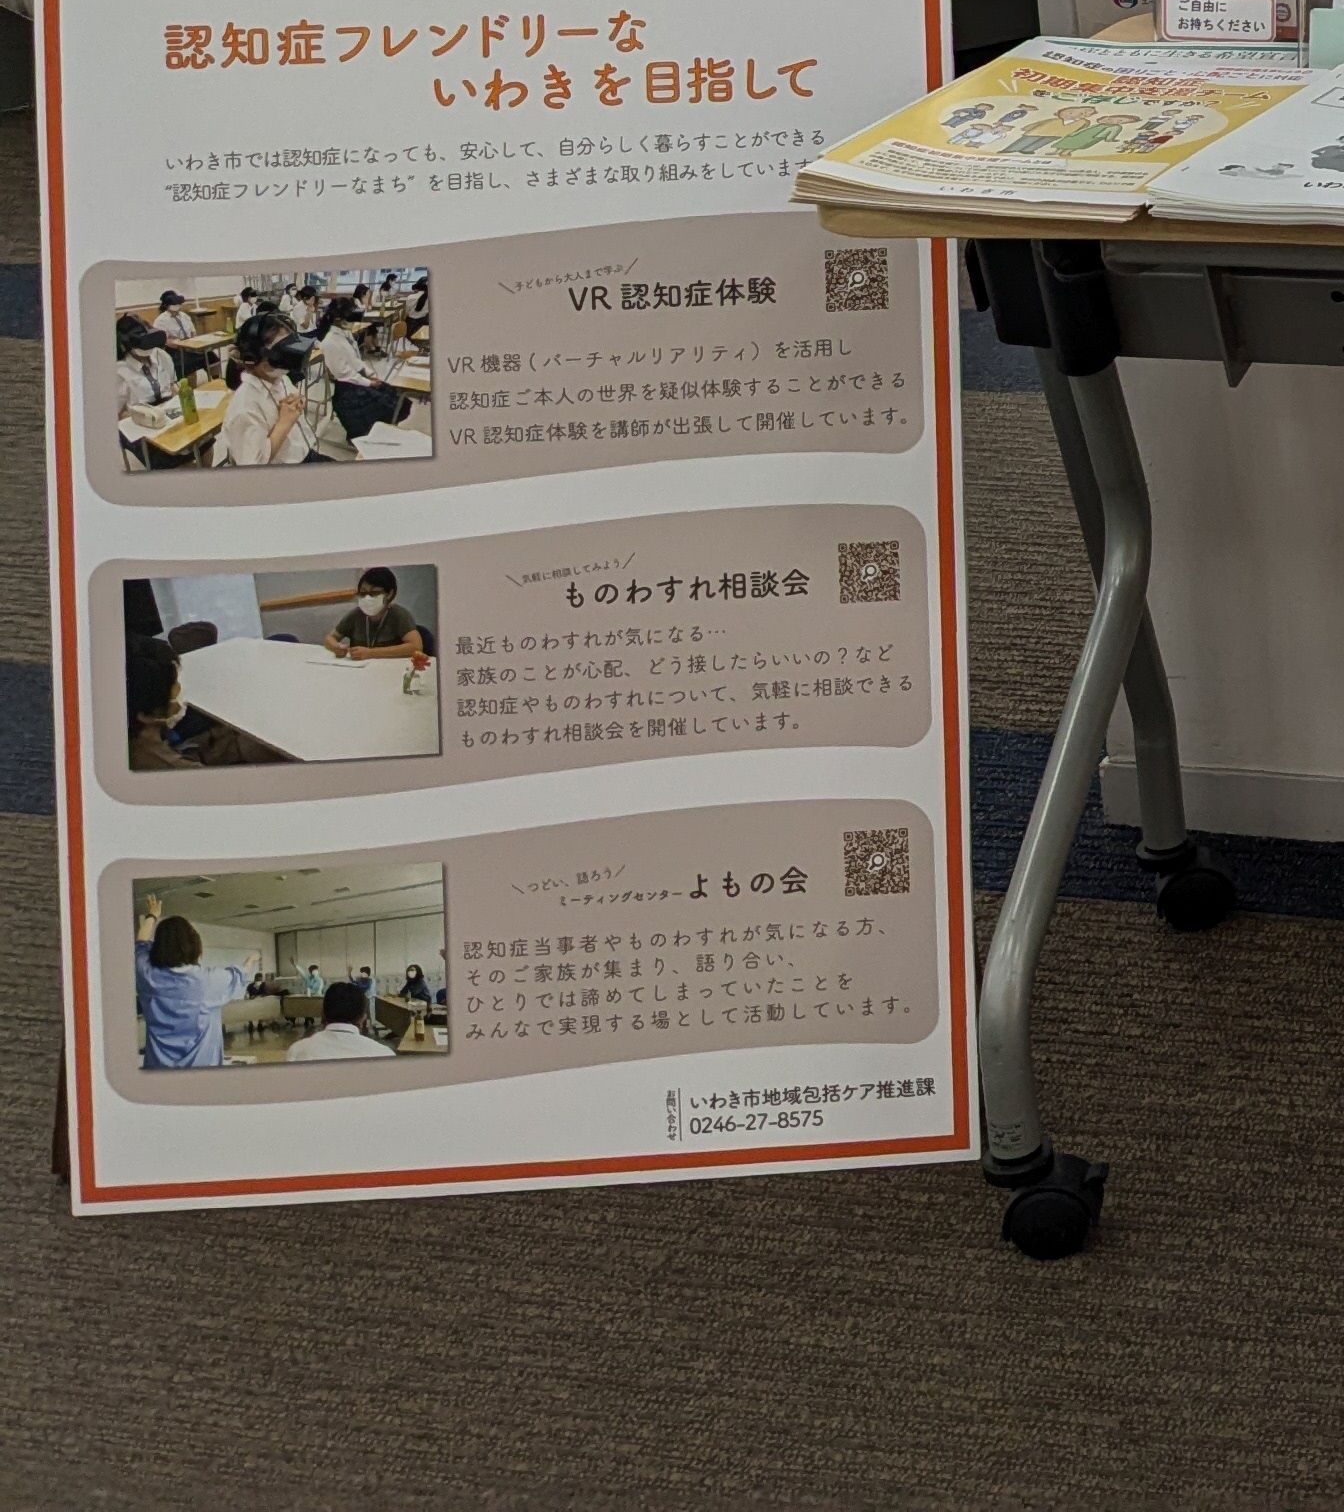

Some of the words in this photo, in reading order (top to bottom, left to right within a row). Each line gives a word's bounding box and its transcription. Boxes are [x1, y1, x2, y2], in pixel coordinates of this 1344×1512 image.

[1178, 0, 1227, 12] ご自由に
[1178, 18, 1265, 32] お持ちください
[164, 9, 648, 69] 認知症フレンドリーな
[433, 57, 820, 111] いわきを目指して
[449, 372, 906, 410] 認知症ご本人の世界を疑似体験することができる
[566, 568, 810, 609] ものわすれ相談会
[455, 644, 894, 687] 家族のことが心配、どう接したらいいの？など
[456, 673, 913, 718] 認知症やものわすれについて、気軽に相談できる
[462, 709, 801, 748] ものわすれ相談会を開催しています。
[689, 865, 810, 900] よもの会
[463, 916, 889, 961] 認知症当事者やものわすれが気になる方、
[467, 950, 796, 986] そのご家族が集まり、語り合い、
[467, 972, 853, 1014] ひとりでは諦めてしまっていたことを
[465, 996, 914, 1041] みんなで実現する場として活動しています。
[691, 1077, 936, 1111] いわき市地域包括ケア推進課
[689, 1108, 825, 1136] 0246-27-8575
